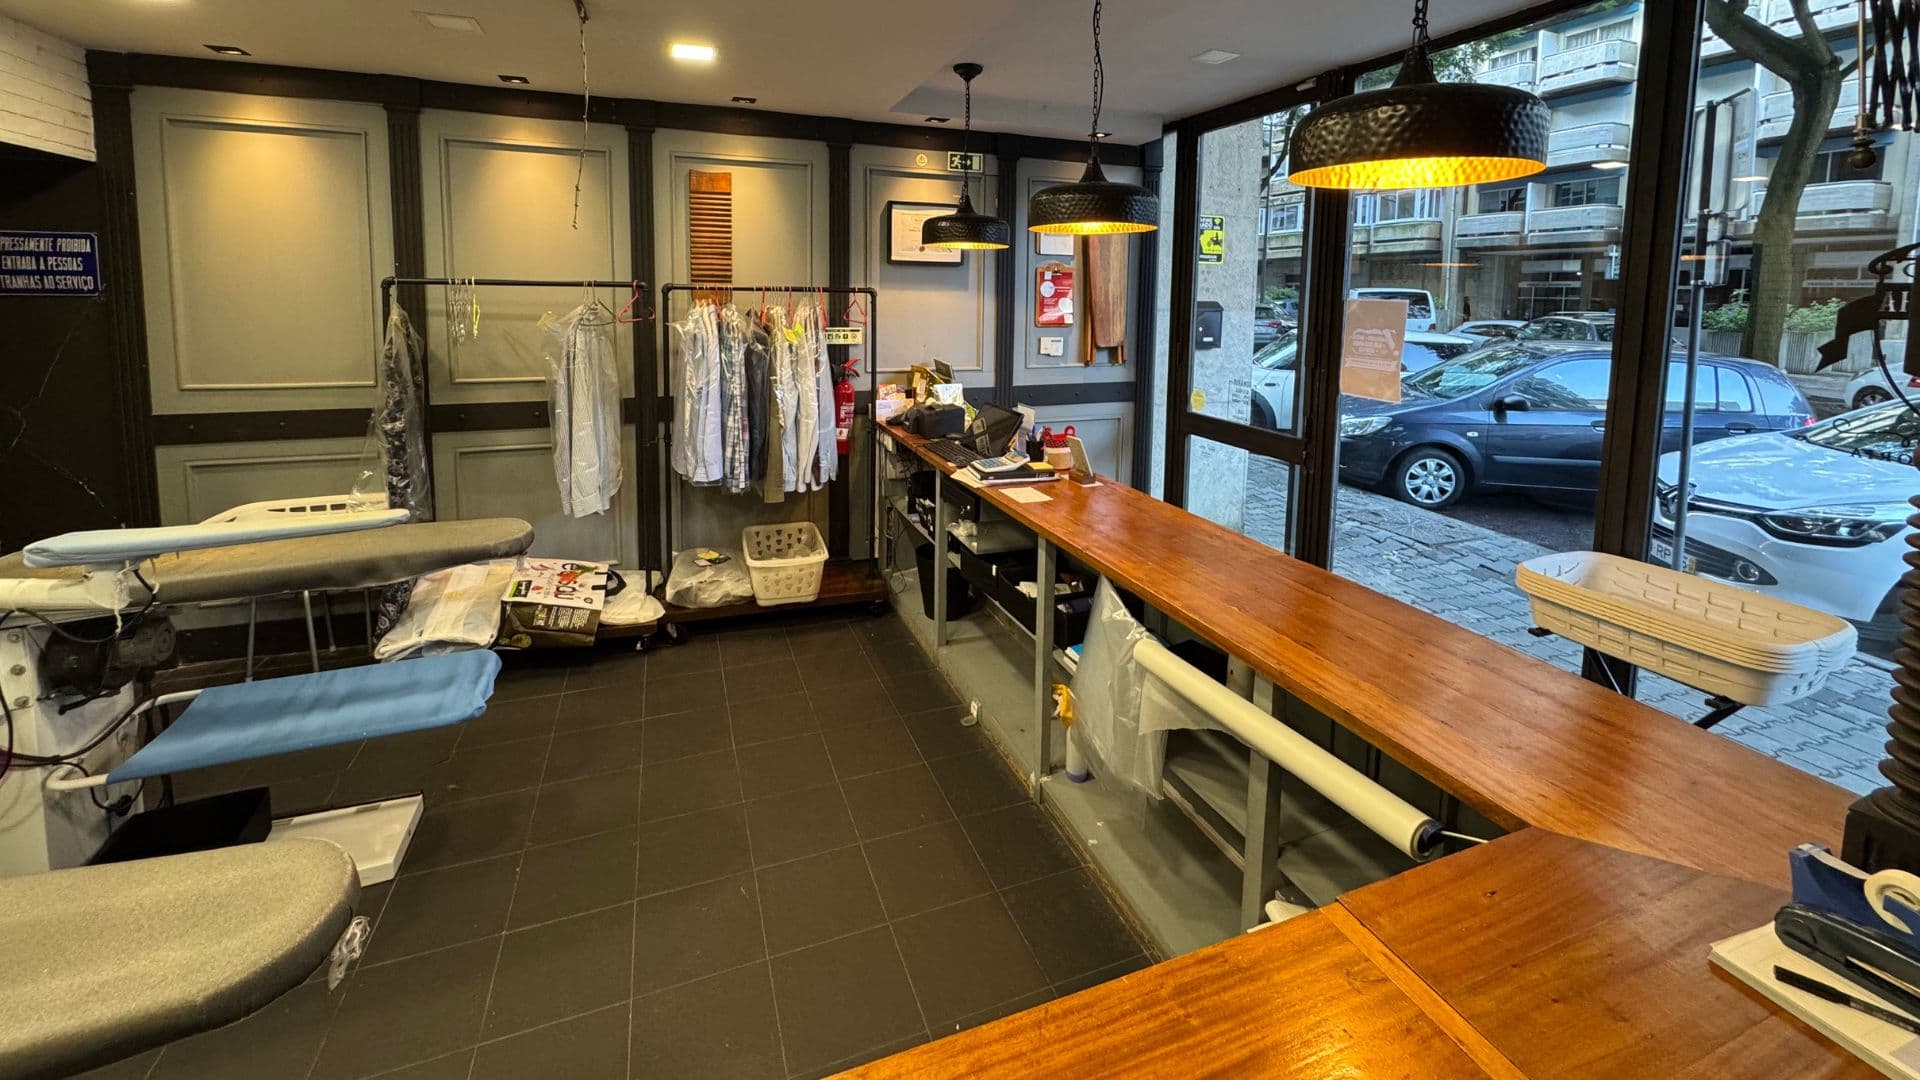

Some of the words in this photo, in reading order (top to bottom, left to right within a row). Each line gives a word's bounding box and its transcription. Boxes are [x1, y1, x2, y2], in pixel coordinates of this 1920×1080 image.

[56, 238, 91, 252] PROIBIDA
[2, 255, 37, 270] ENTRADA
[40, 256, 46, 271] A
[47, 256, 83, 271] PESSOAS
[43, 275, 55, 289] AO
[56, 275, 94, 291] SERVIÇO
